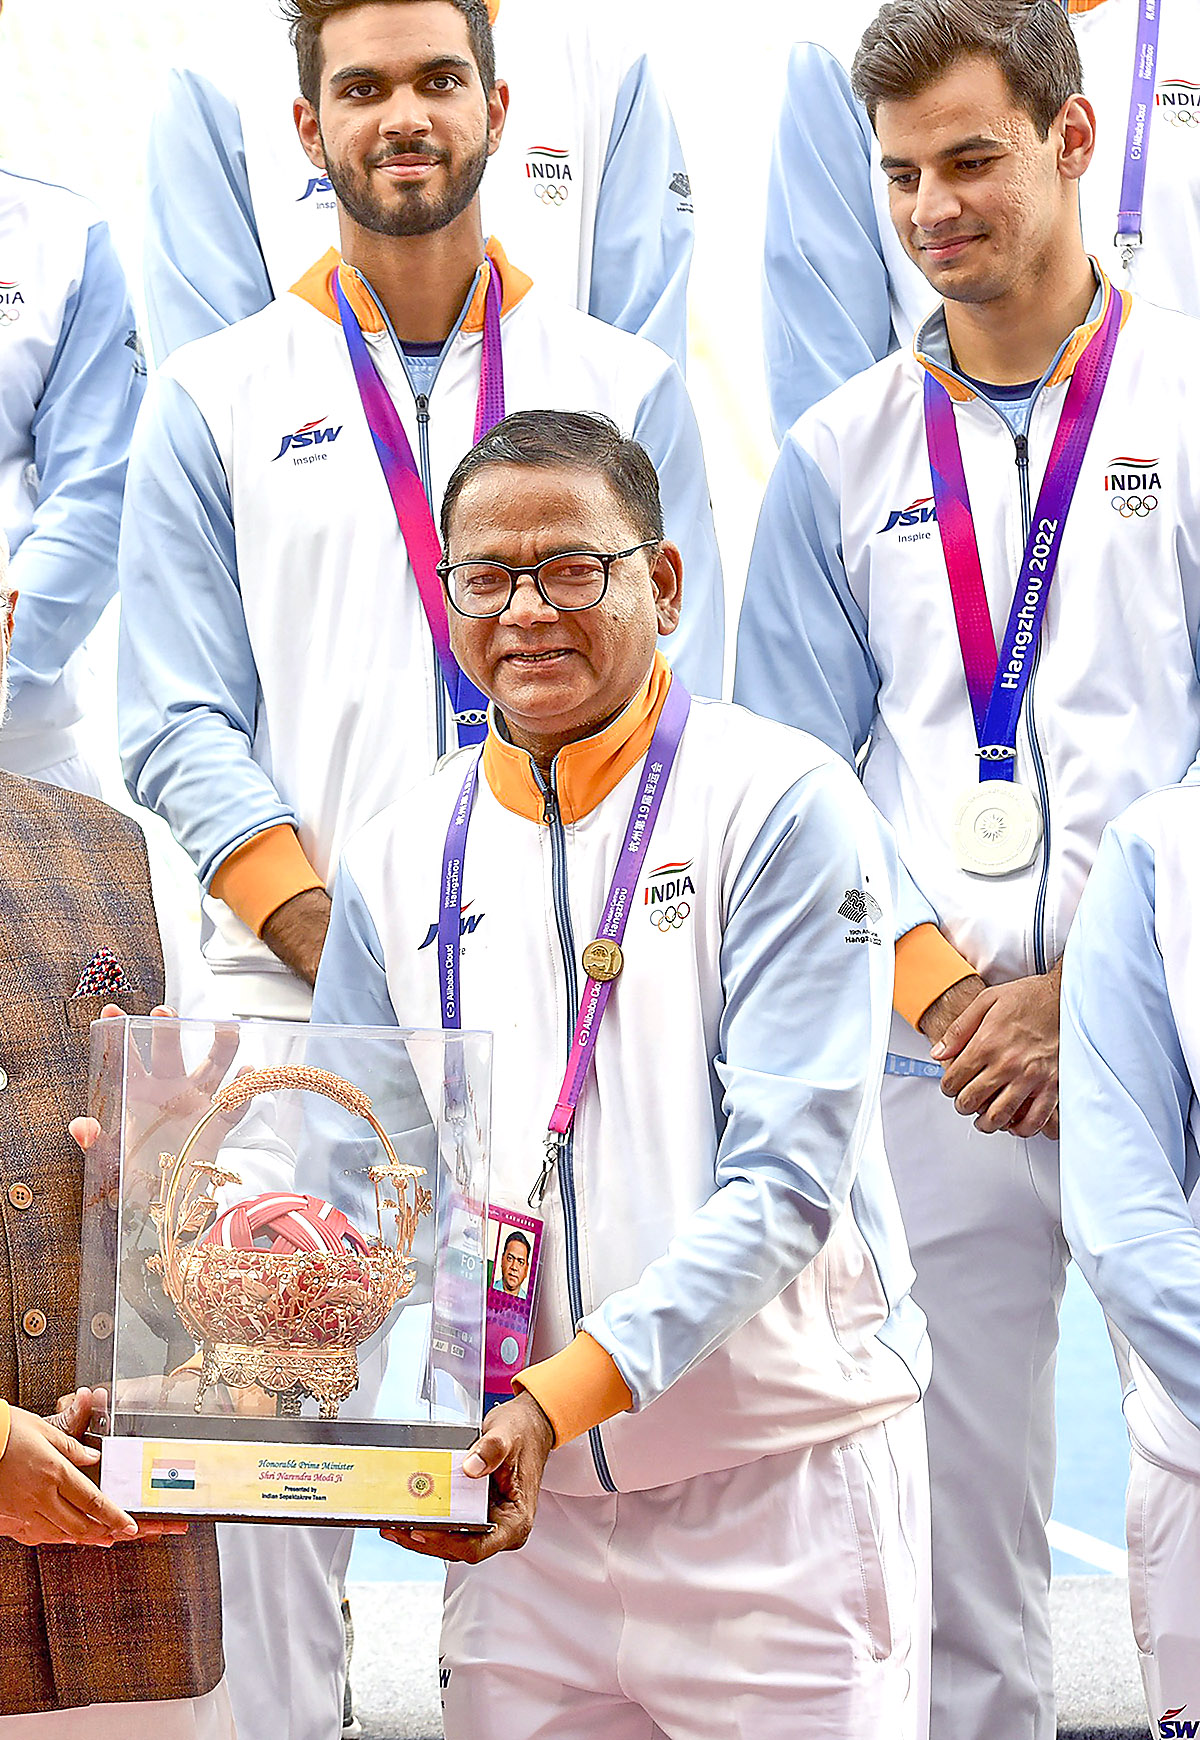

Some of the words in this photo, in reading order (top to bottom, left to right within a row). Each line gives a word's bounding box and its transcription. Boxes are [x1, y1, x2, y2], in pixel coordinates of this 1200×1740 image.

[526, 163, 572, 180] INDIA
[296, 178, 333, 201] JS
[270, 425, 343, 462] JSW
[293, 453, 328, 466] Inspire
[1104, 473, 1161, 491] INDIA
[898, 532, 931, 543] Inspire
[1001, 576, 1043, 689] Hangzhou
[1028, 518, 1058, 572] 2022
[450, 859, 460, 908] Hangzhou
[645, 876, 695, 905] INDIA
[608, 887, 628, 937] Hangzhou
[418, 913, 485, 950] JW
[445, 943, 454, 968] Cloud
[446, 969, 454, 1001] Alibaba
[583, 998, 598, 1030] Alibaba
[258, 1460, 296, 1468] Honorable
[299, 1461, 319, 1469] Prime
[322, 1462, 354, 1470] Minister
[259, 1471, 275, 1480] Shri
[277, 1472, 311, 1481] Narendra
[313, 1473, 333, 1482] Modi
[334, 1474, 343, 1483] Ji
[1159, 1720, 1200, 1739] SW
